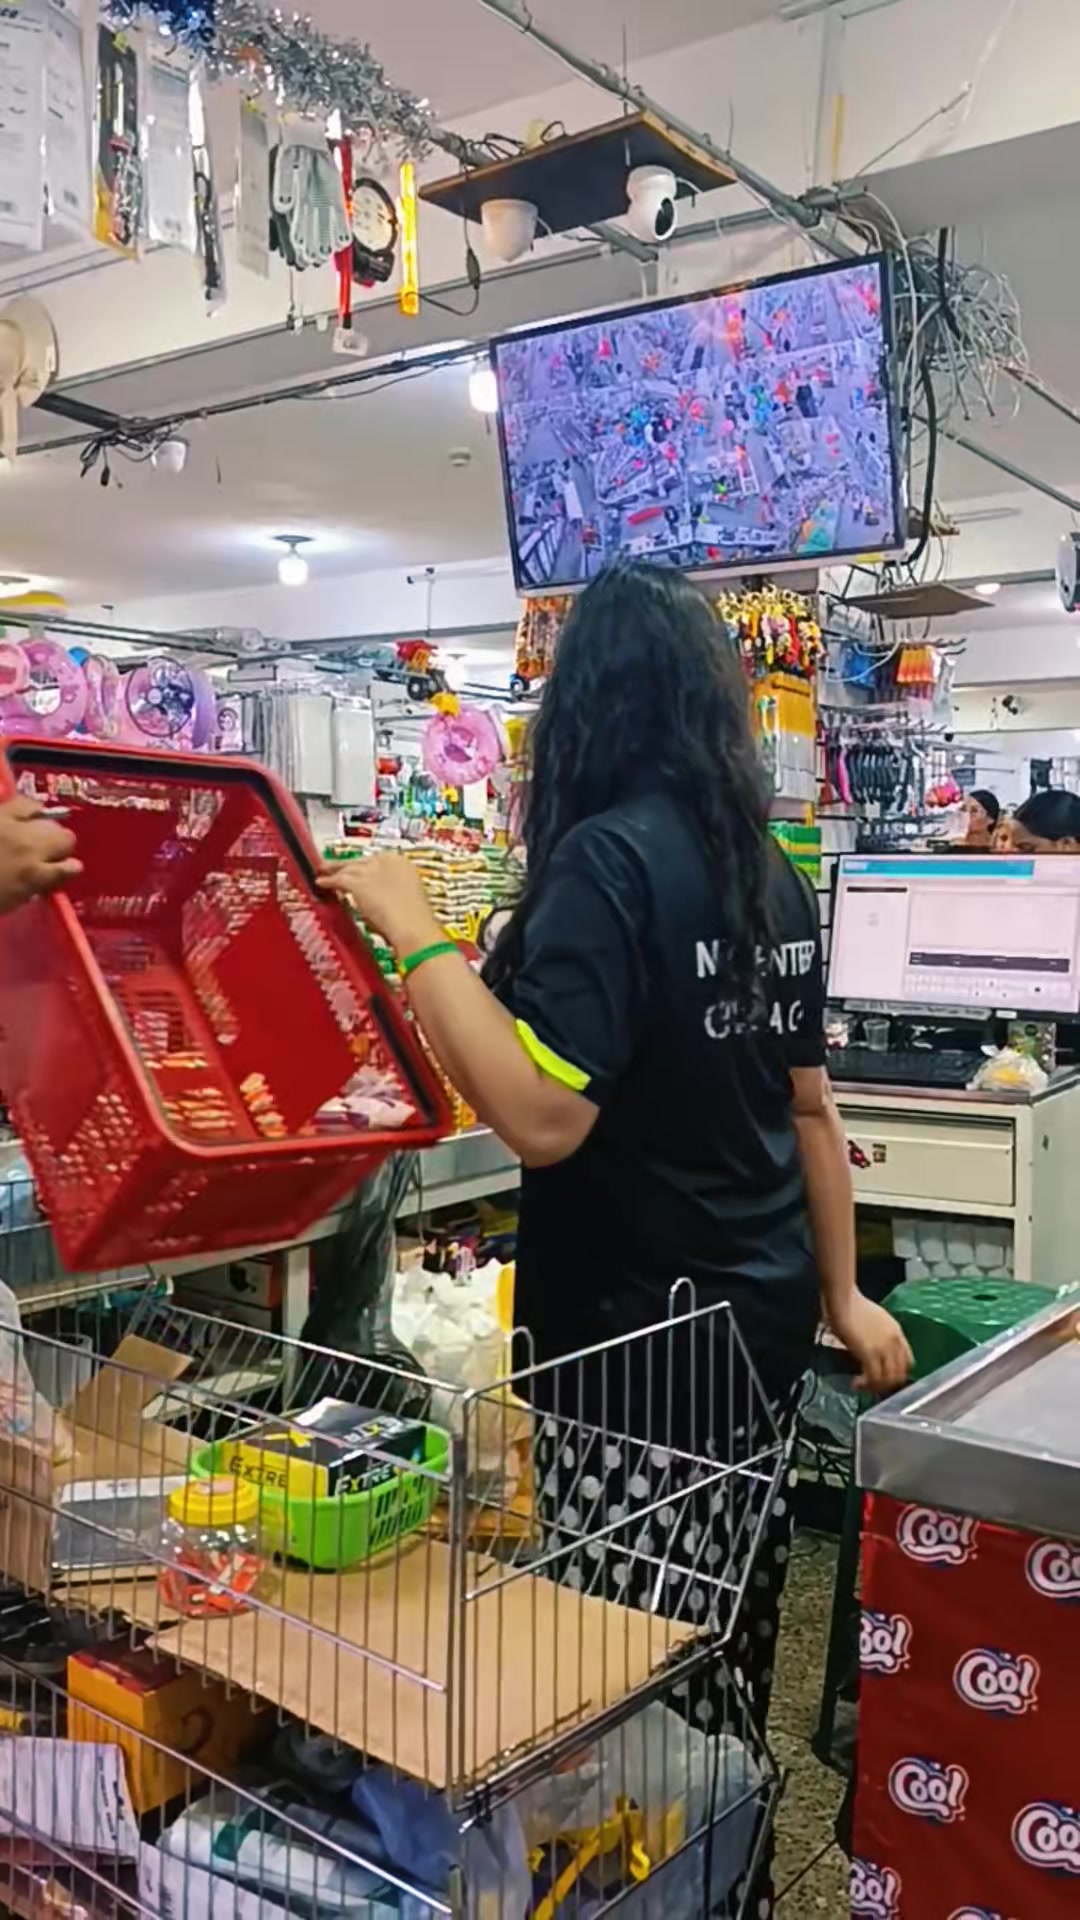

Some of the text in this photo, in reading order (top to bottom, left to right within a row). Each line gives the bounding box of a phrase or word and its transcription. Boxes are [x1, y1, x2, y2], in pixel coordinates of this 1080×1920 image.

[899, 1506, 976, 1561] Cool
[1028, 1541, 1080, 1595] Co
[860, 1616, 908, 1670] ool
[957, 1652, 1037, 1711] Cool
[891, 1761, 965, 1819] Cool
[1015, 1805, 1080, 1869] Coo
[851, 1862, 899, 1918] ool
